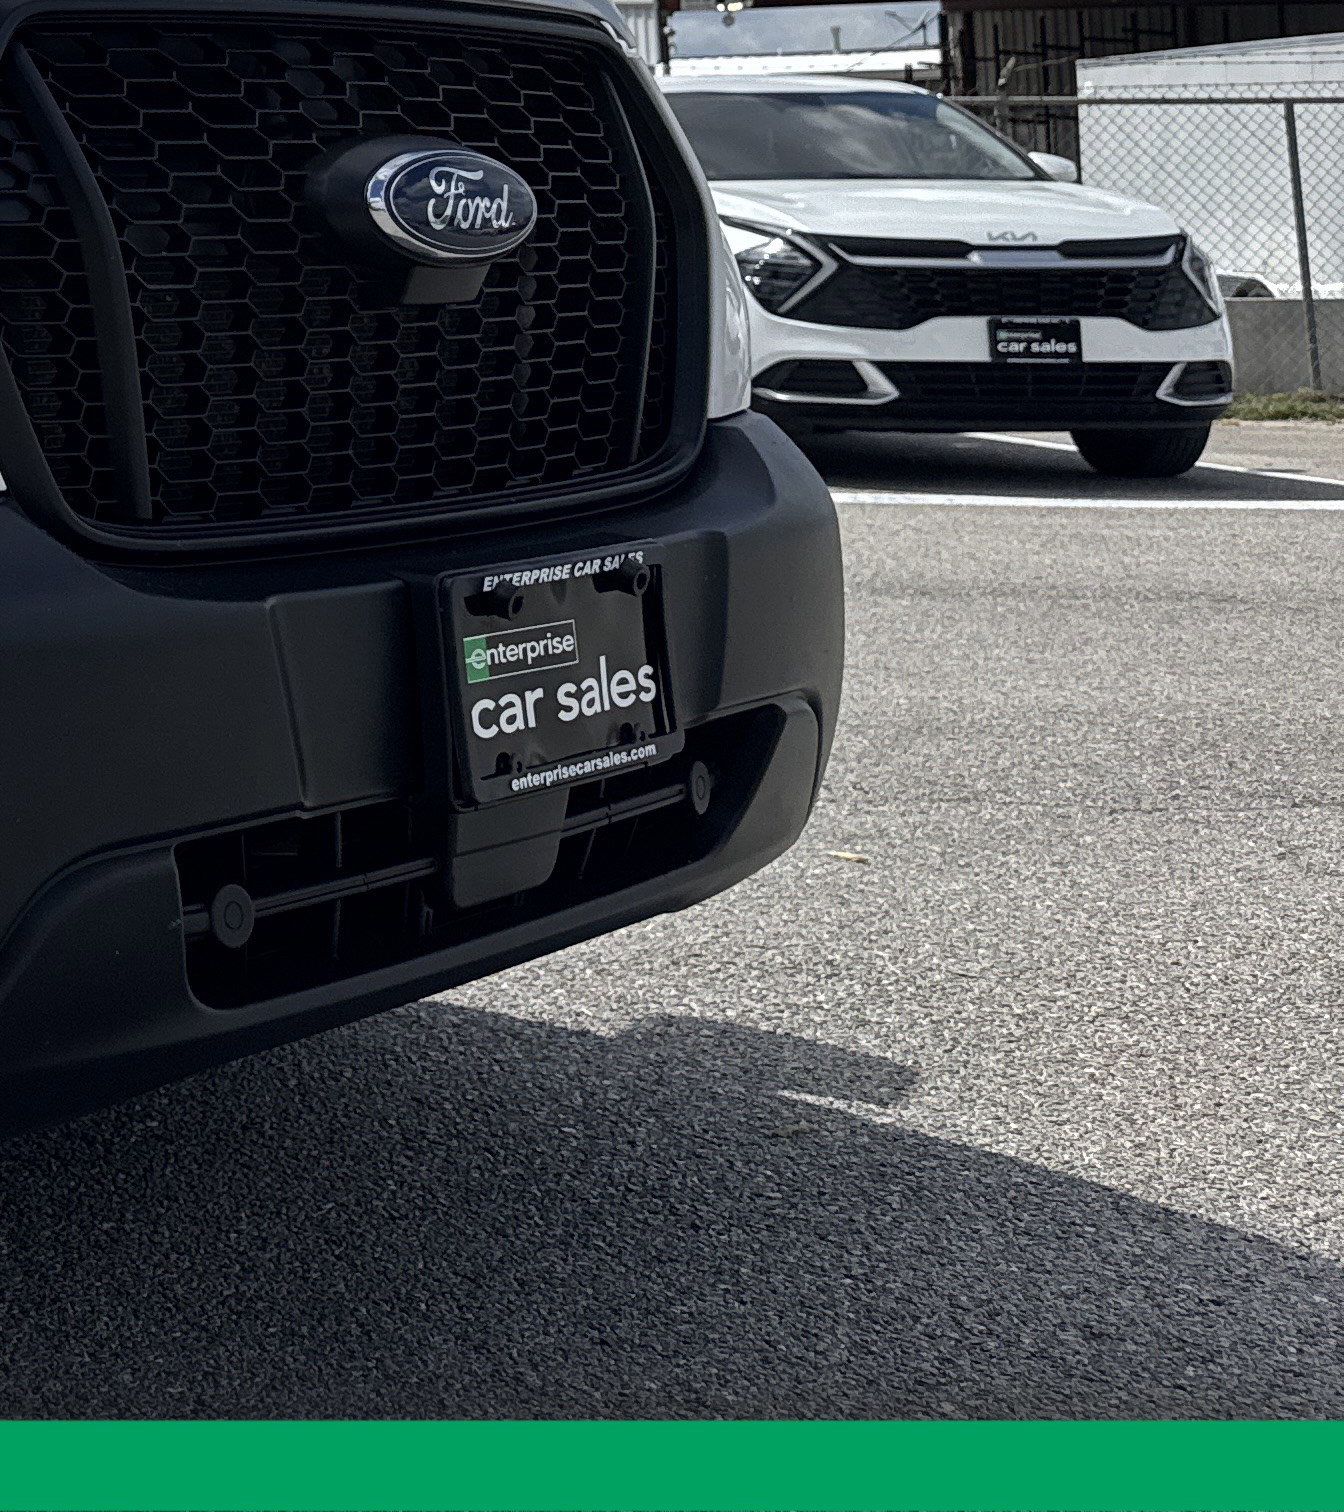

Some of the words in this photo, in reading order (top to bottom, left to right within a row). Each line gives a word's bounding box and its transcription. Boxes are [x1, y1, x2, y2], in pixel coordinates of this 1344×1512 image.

[427, 166, 516, 230] Ford
[997, 341, 1028, 353] car
[1030, 338, 1077, 353] sales
[574, 559, 601, 577] CAR
[466, 633, 574, 669] enterprise
[471, 688, 543, 738] car
[557, 655, 656, 721] sales
[512, 744, 656, 791] enterprisecarsales.com
